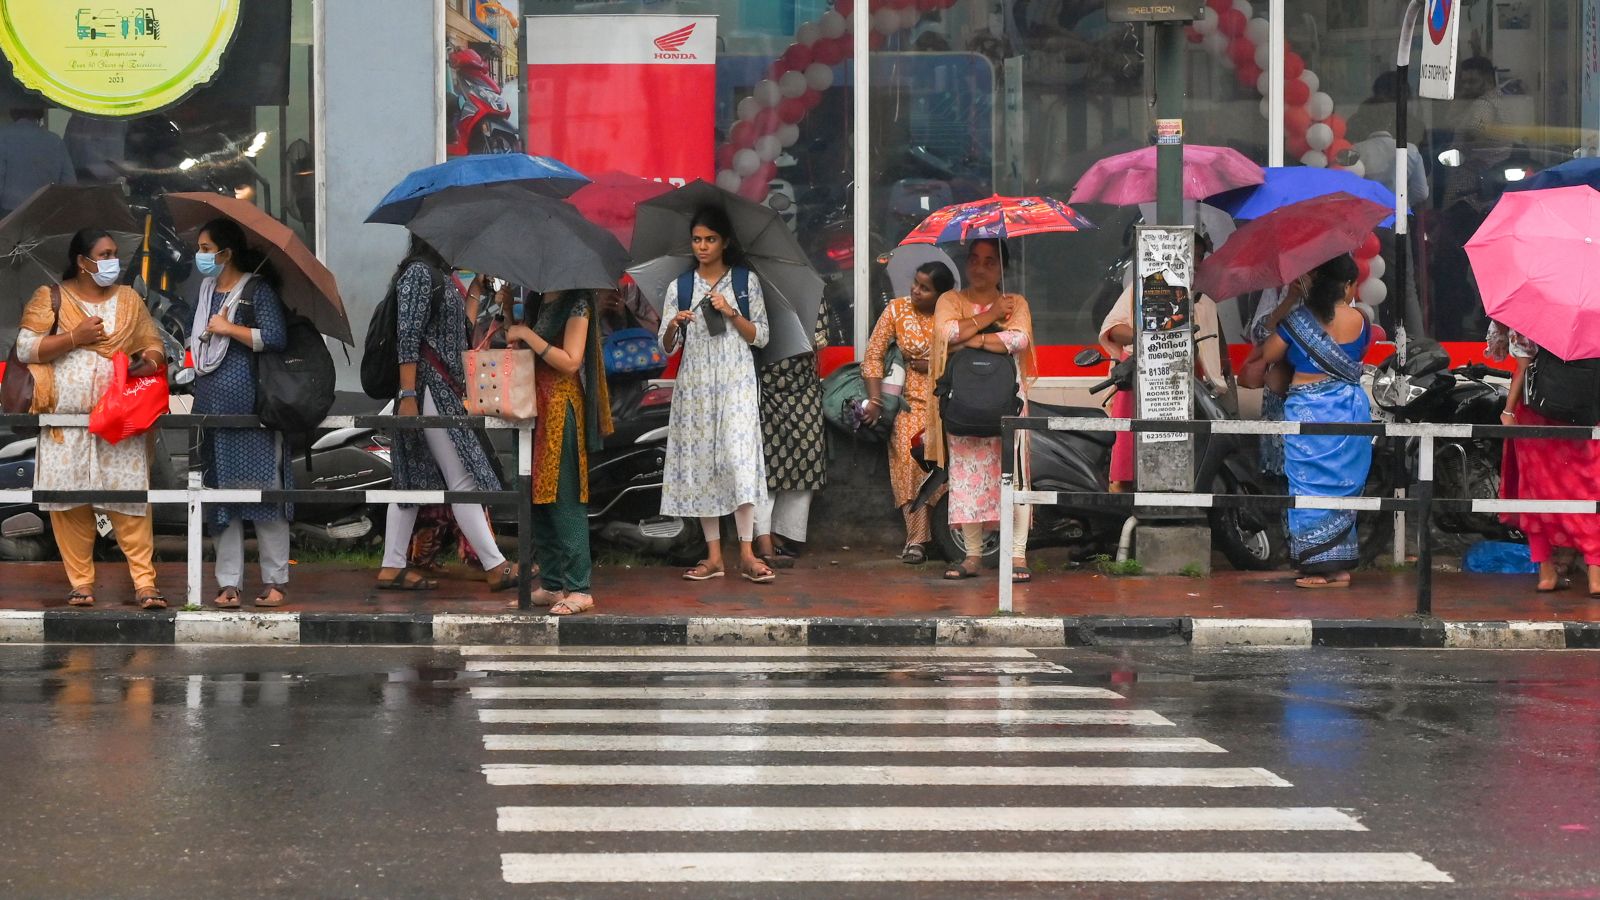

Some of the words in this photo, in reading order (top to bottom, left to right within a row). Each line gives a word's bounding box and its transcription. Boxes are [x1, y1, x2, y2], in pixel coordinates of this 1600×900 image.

[1134, 6, 1175, 14] KELTRON
[1428, 64, 1449, 82] STOPPING
[108, 76, 124, 84] 2023
